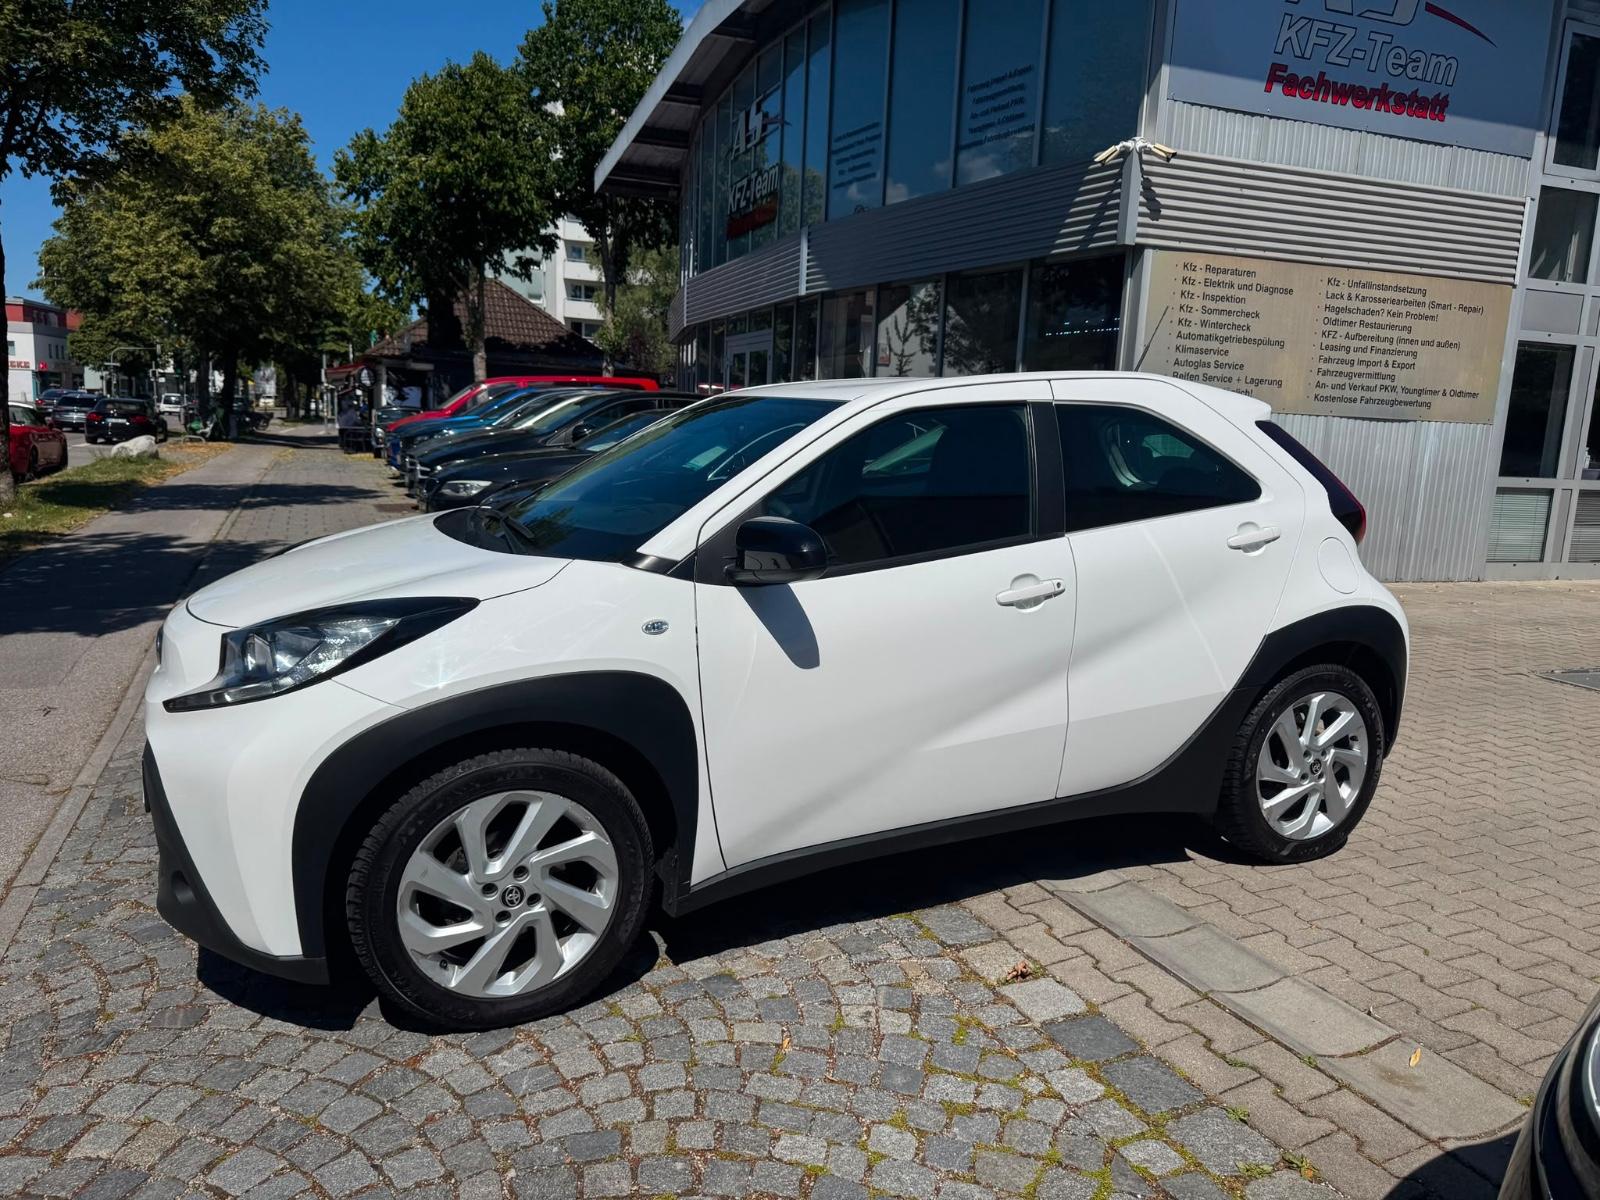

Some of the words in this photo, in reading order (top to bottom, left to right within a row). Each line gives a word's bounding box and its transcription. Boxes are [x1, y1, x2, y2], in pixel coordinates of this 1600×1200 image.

[1273, 12, 1459, 87] KFZ-Team
[1264, 62, 1450, 122] Fachwerkstatt
[728, 164, 780, 215] KFZ-Team
[1183, 262, 1197, 272] Kfz
[1205, 264, 1256, 278] Reparaturen
[1182, 276, 1196, 286] Kfz
[1204, 278, 1235, 290] Elektrik
[1238, 283, 1253, 292] und
[1256, 283, 1294, 295] Diagnose
[1328, 277, 1340, 287] Kfz
[1348, 280, 1427, 297] Unfallinstandsetzung
[1180, 290, 1195, 300] Kfz
[1202, 292, 1246, 304] Inspektion
[1326, 291, 1345, 301] Lack
[1347, 292, 1353, 301] &
[1355, 293, 1426, 308] Karosseriearbeiten
[1428, 300, 1452, 311] (Smart
[1458, 304, 1484, 315] Repair)
[1179, 304, 1193, 314] Kfz
[1201, 305, 1260, 319] Sommercheck
[1324, 304, 1385, 317] Hagelschaden?
[1387, 309, 1403, 319] Kein
[1405, 311, 1439, 322] Problem!
[1178, 317, 1192, 327] Kfz
[1200, 320, 1251, 332] Wintercheck
[1323, 317, 1357, 327] Oldtimer
[1359, 320, 1412, 334] Restaurierung
[1176, 331, 1285, 349] Automatikgetriebespülung
[1322, 329, 1338, 339] KFZ
[1344, 332, 1394, 345] Aufbereitung
[1396, 336, 1419, 346] (innen
[1421, 339, 1435, 347] und
[1436, 340, 1461, 351] außen)
[1175, 344, 1229, 356] Klimaservice
[1320, 342, 1351, 354] Leasing
[1370, 346, 1418, 359] Finanzierung
[1174, 358, 1211, 370] Autoglas
[1213, 360, 1245, 371] Service
[1319, 355, 1355, 367] Fahrzeug
[1357, 358, 1382, 368] Import
[1384, 360, 1389, 368] &
[1392, 360, 1416, 370] Export
[1172, 371, 1200, 381] Reifen
[1202, 373, 1233, 383] Service
[1245, 375, 1283, 387] Lagerung
[1317, 368, 1396, 382] Fahrzeugvermittlung
[1315, 380, 1329, 389] An-
[1348, 382, 1377, 392] Verkauf
[1379, 384, 1398, 394] PKW,
[1400, 386, 1440, 397] Youngtimer
[1442, 388, 1447, 397] &
[1449, 389, 1479, 399] Oldtimer
[1314, 393, 1358, 403] Kostenlose
[1360, 396, 1432, 409] Fahrzeugbewertung
